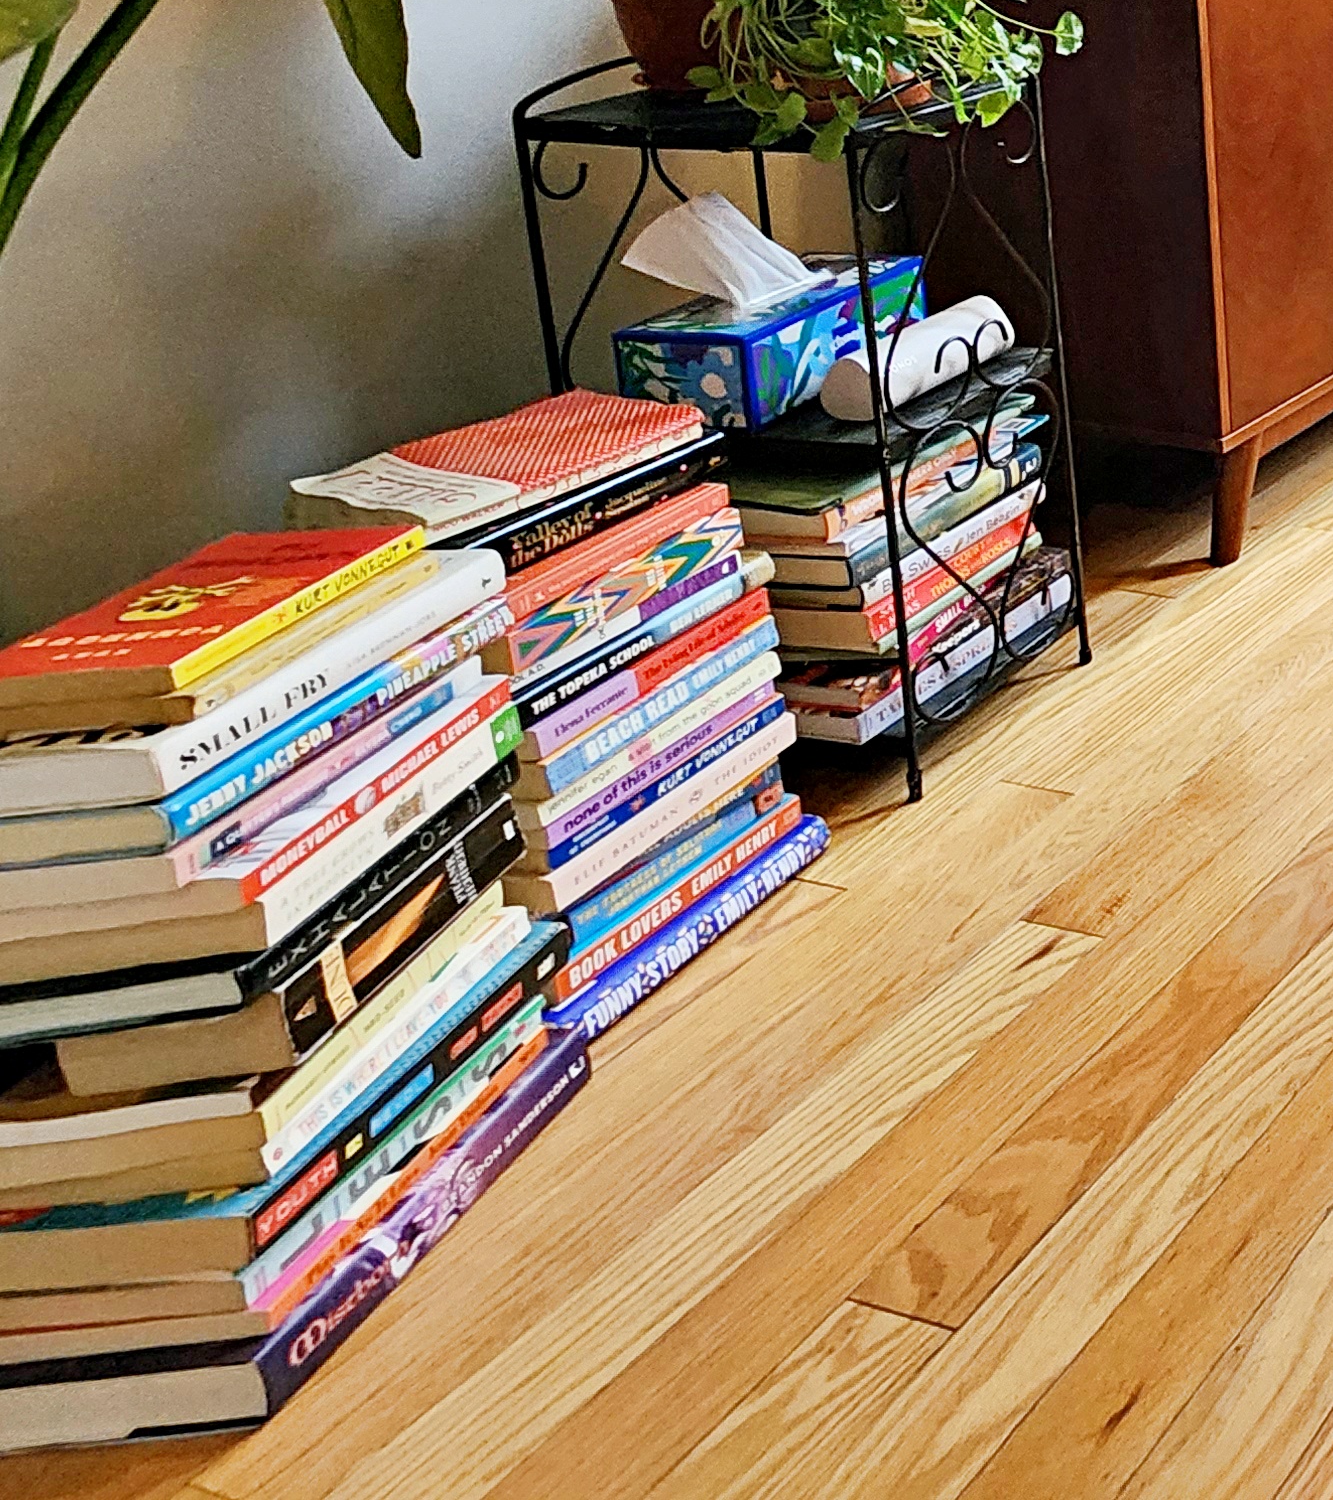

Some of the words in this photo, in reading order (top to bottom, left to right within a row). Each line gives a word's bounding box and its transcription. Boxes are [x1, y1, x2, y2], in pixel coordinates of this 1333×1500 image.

[335, 543, 399, 593] VONNEGUT
[509, 508, 573, 548] Valley
[510, 543, 542, 568] the
[544, 520, 595, 555] Dolls
[908, 544, 951, 579] Swss
[185, 773, 247, 826] JENNY
[252, 723, 334, 783] JACKSON
[376, 645, 458, 707] PINEAPPLE
[462, 606, 516, 654] STREET
[530, 690, 557, 716] THE
[557, 665, 608, 698] TOPEKA
[609, 635, 656, 670] SCHOOL
[682, 711, 698, 726] the
[725, 677, 752, 701] squad
[180, 707, 278, 771] SMALL
[284, 668, 331, 710] FRY
[553, 714, 584, 738] Elena
[583, 712, 643, 764] BEACH
[645, 685, 690, 728] READ
[657, 760, 693, 797] KURT
[694, 717, 759, 768] VONNEGUT
[259, 809, 351, 887] MONEYBALL
[380, 740, 440, 793] MICHAEL
[441, 708, 480, 747] LEWIS
[563, 802, 601, 833] none
[602, 788, 619, 804] of
[620, 768, 648, 793] this
[650, 759, 662, 776] is
[664, 724, 713, 763] serious
[612, 807, 679, 858] BATUMAN
[743, 736, 779, 766] IDIOT
[267, 819, 453, 978] EXHALATION
[568, 936, 617, 991] BOOK
[620, 891, 683, 947] LOVERS
[690, 851, 733, 896] EMILY
[735, 819, 778, 864] HENRY
[583, 974, 643, 1037] FUNNY
[643, 927, 700, 994] STORY
[713, 882, 759, 933] EMILY
[760, 845, 808, 896] HENRY
[440, 1144, 502, 1214] BRANDON
[503, 1075, 570, 1148] SANDERSON
[258, 1153, 338, 1236] YOUTH
